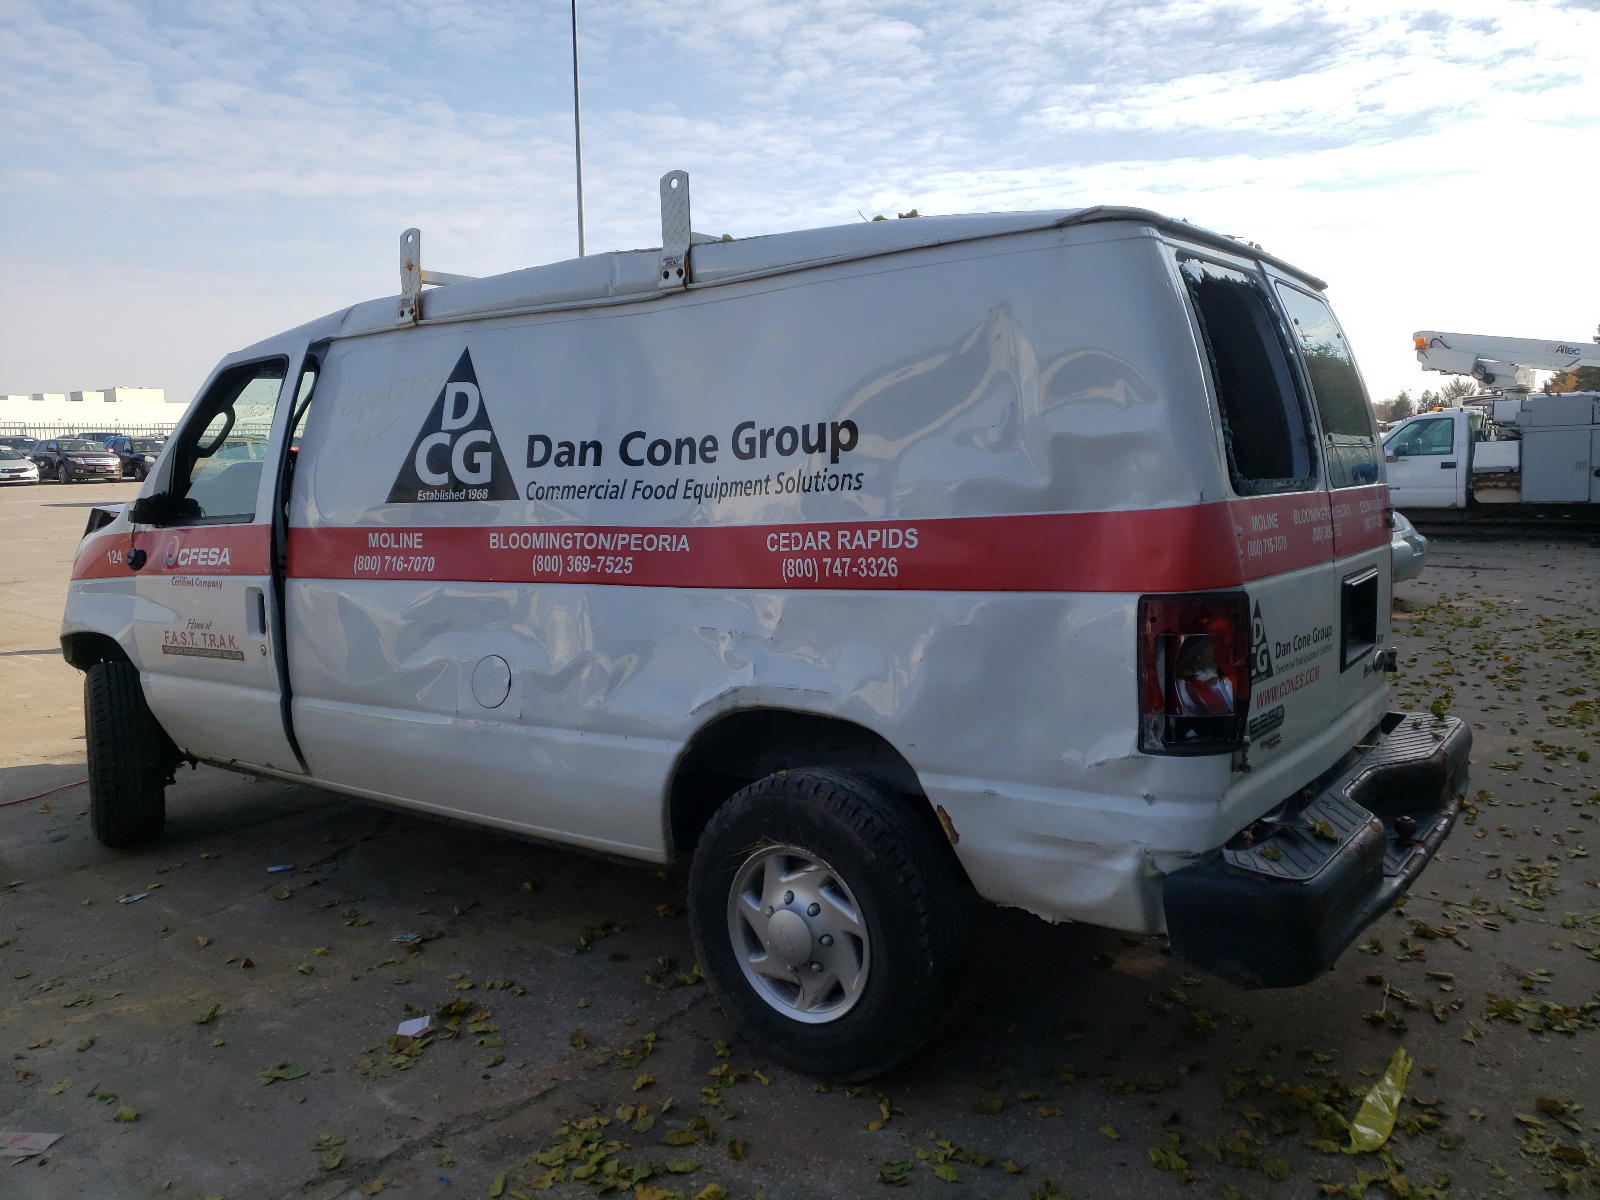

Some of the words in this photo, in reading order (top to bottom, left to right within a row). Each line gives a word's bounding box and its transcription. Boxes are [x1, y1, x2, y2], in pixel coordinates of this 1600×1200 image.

[1555, 344, 1581, 356] Altec
[526, 434, 603, 469] Dan
[618, 430, 719, 467] Cone
[731, 419, 859, 464] Group
[417, 489, 465, 501] Established
[467, 488, 488, 500] 1968
[526, 478, 628, 502] Commercial
[631, 478, 679, 501] Food
[683, 475, 771, 504] Equipment
[775, 468, 864, 495] Solutions
[1251, 512, 1279, 532] MOLINE
[368, 532, 423, 549] MOLINE
[489, 532, 690, 552] BLOOMINGTON/PEORIA
[766, 531, 831, 552] CEDAR
[837, 528, 919, 550] RAPIDS
[107, 550, 122, 565] 124
[178, 548, 231, 566] CFESA
[353, 555, 381, 575] (800)
[384, 555, 434, 572] 716-7070
[532, 555, 563, 576] (800)
[567, 555, 633, 574] 369-7525
[782, 557, 819, 582] (800)
[823, 557, 898, 578] 747-3326
[172, 576, 194, 587] Certified
[195, 577, 223, 590] Company
[1275, 641, 1291, 660] Dan
[1293, 634, 1311, 652] Cone
[1312, 625, 1333, 643] Group
[1256, 666, 1320, 710] WWW.CONES.COM
